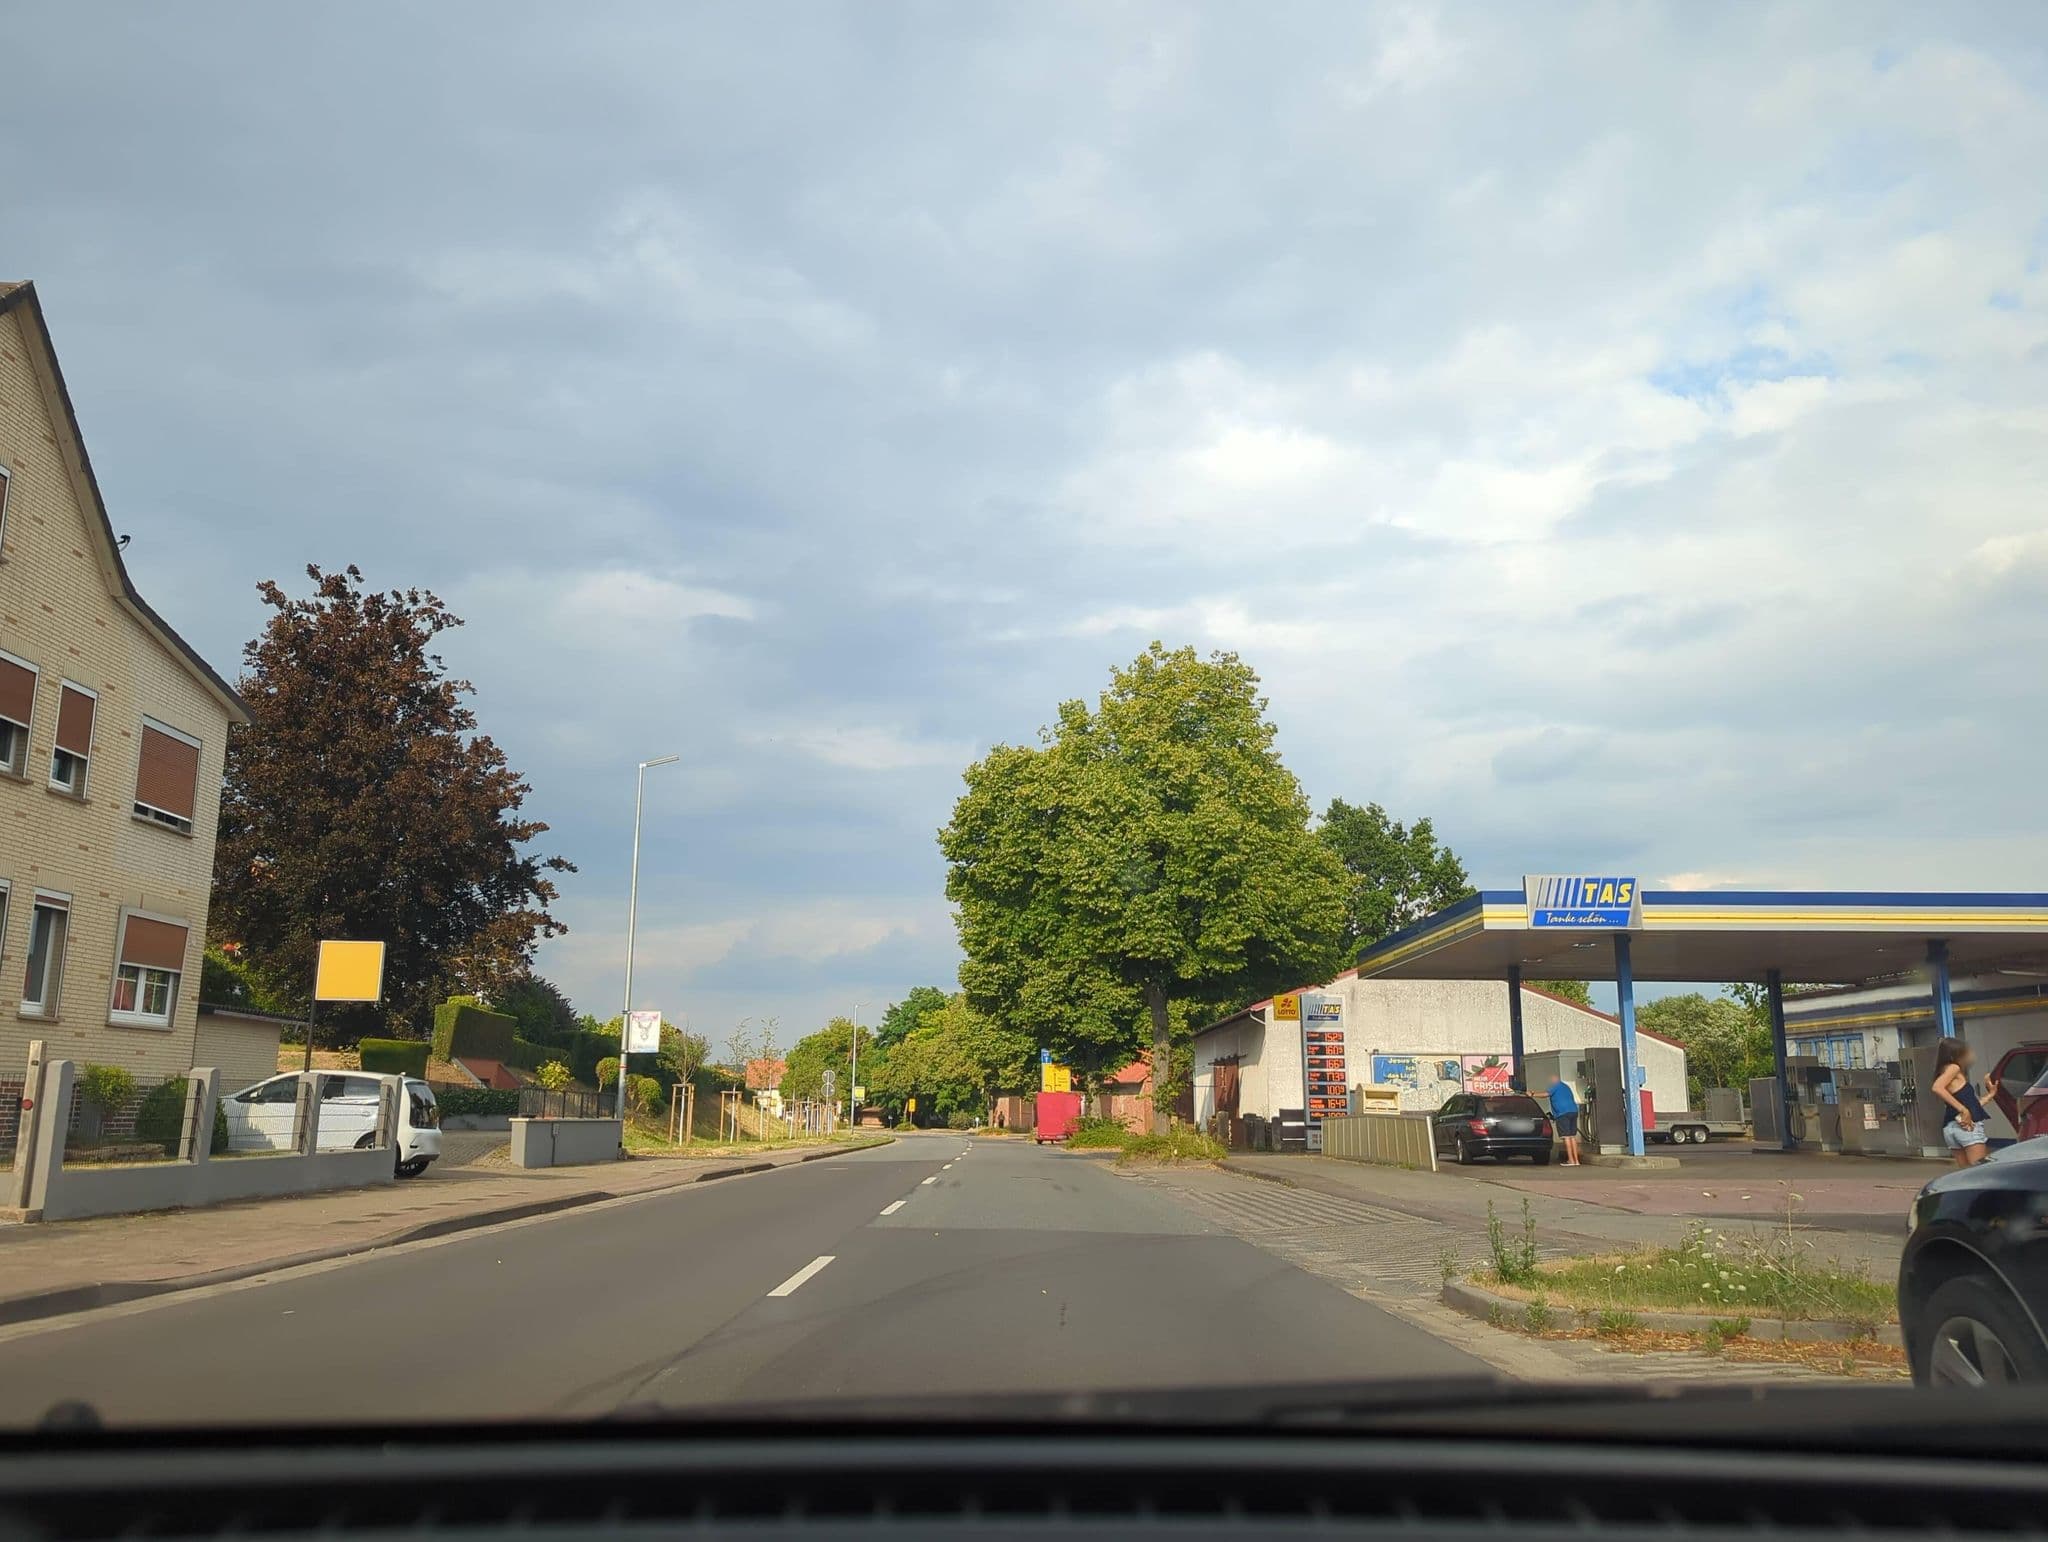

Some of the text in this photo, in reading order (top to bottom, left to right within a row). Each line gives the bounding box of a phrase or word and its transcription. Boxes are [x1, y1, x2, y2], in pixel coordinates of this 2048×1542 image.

[1584, 883, 1632, 904] TAS
[1546, 912, 1576, 924] Tanke
[1323, 1005, 1341, 1014] TAS
